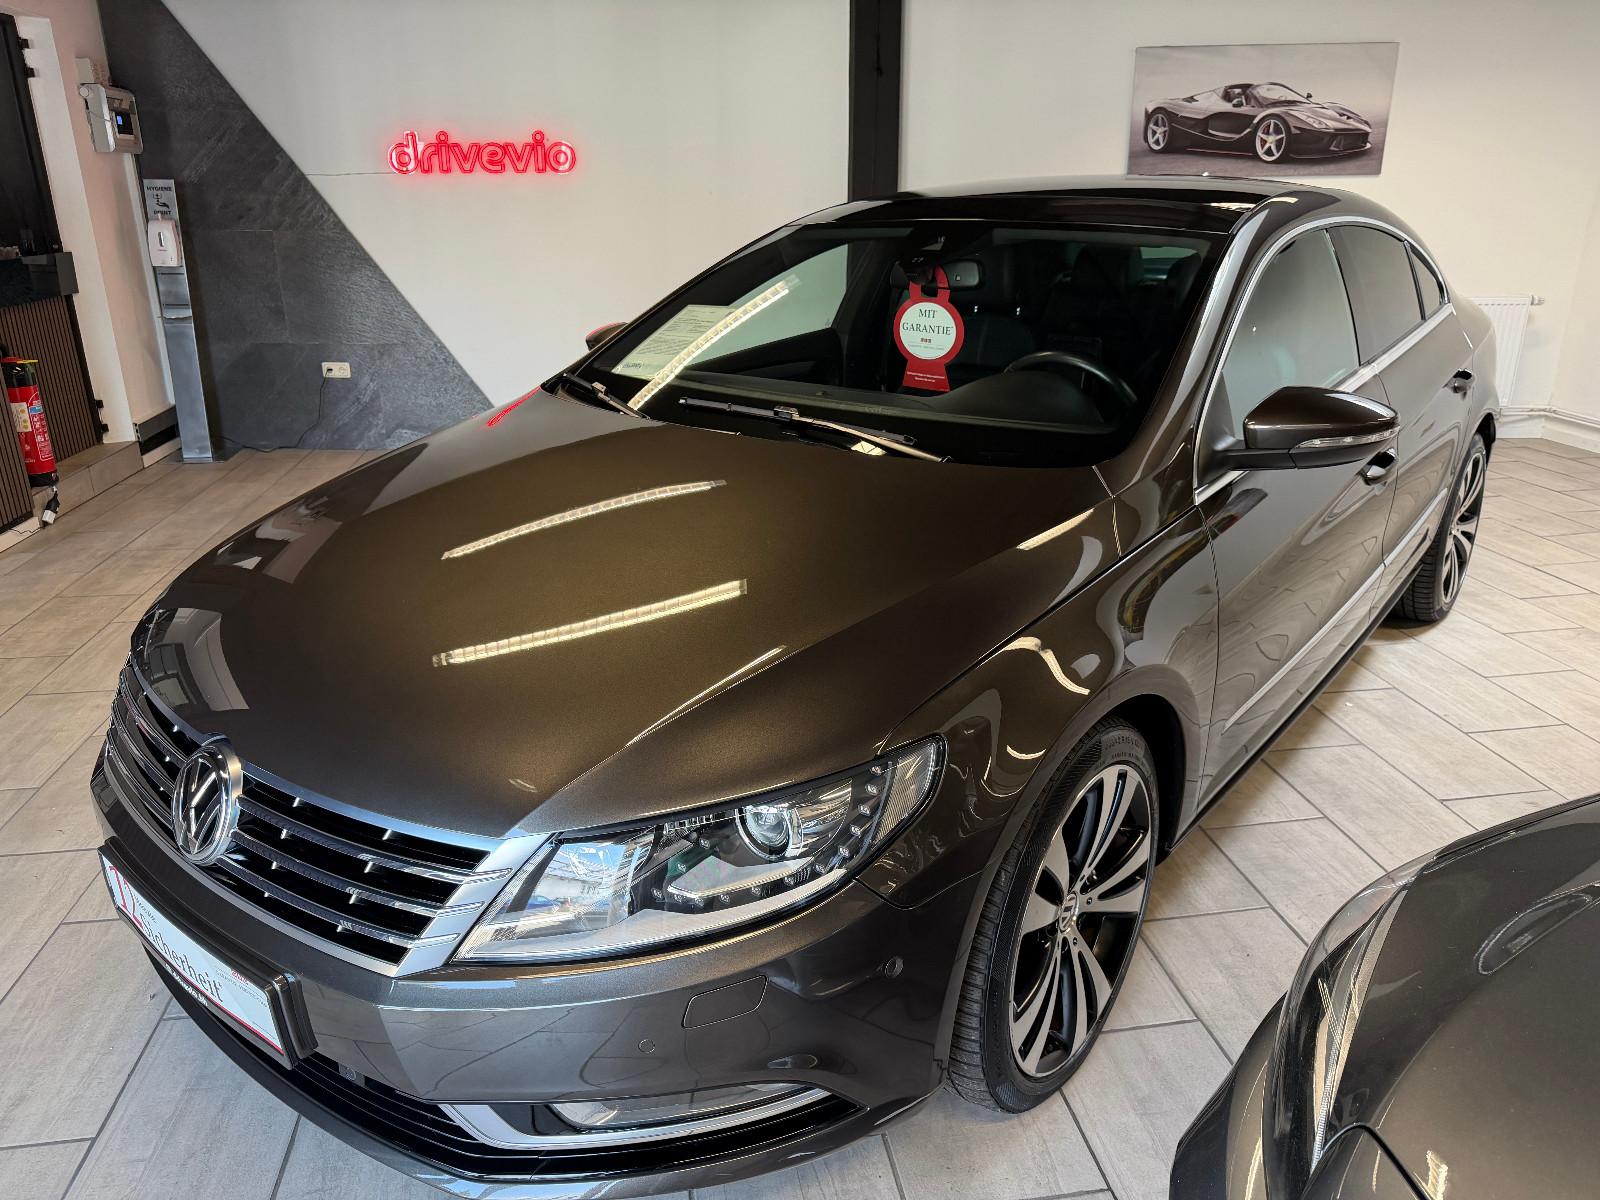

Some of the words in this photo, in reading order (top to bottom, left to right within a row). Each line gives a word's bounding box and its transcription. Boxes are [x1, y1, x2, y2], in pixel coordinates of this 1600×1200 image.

[388, 130, 577, 175] drivevio
[918, 308, 937, 319] MIT
[902, 322, 953, 336] GARANTIE
